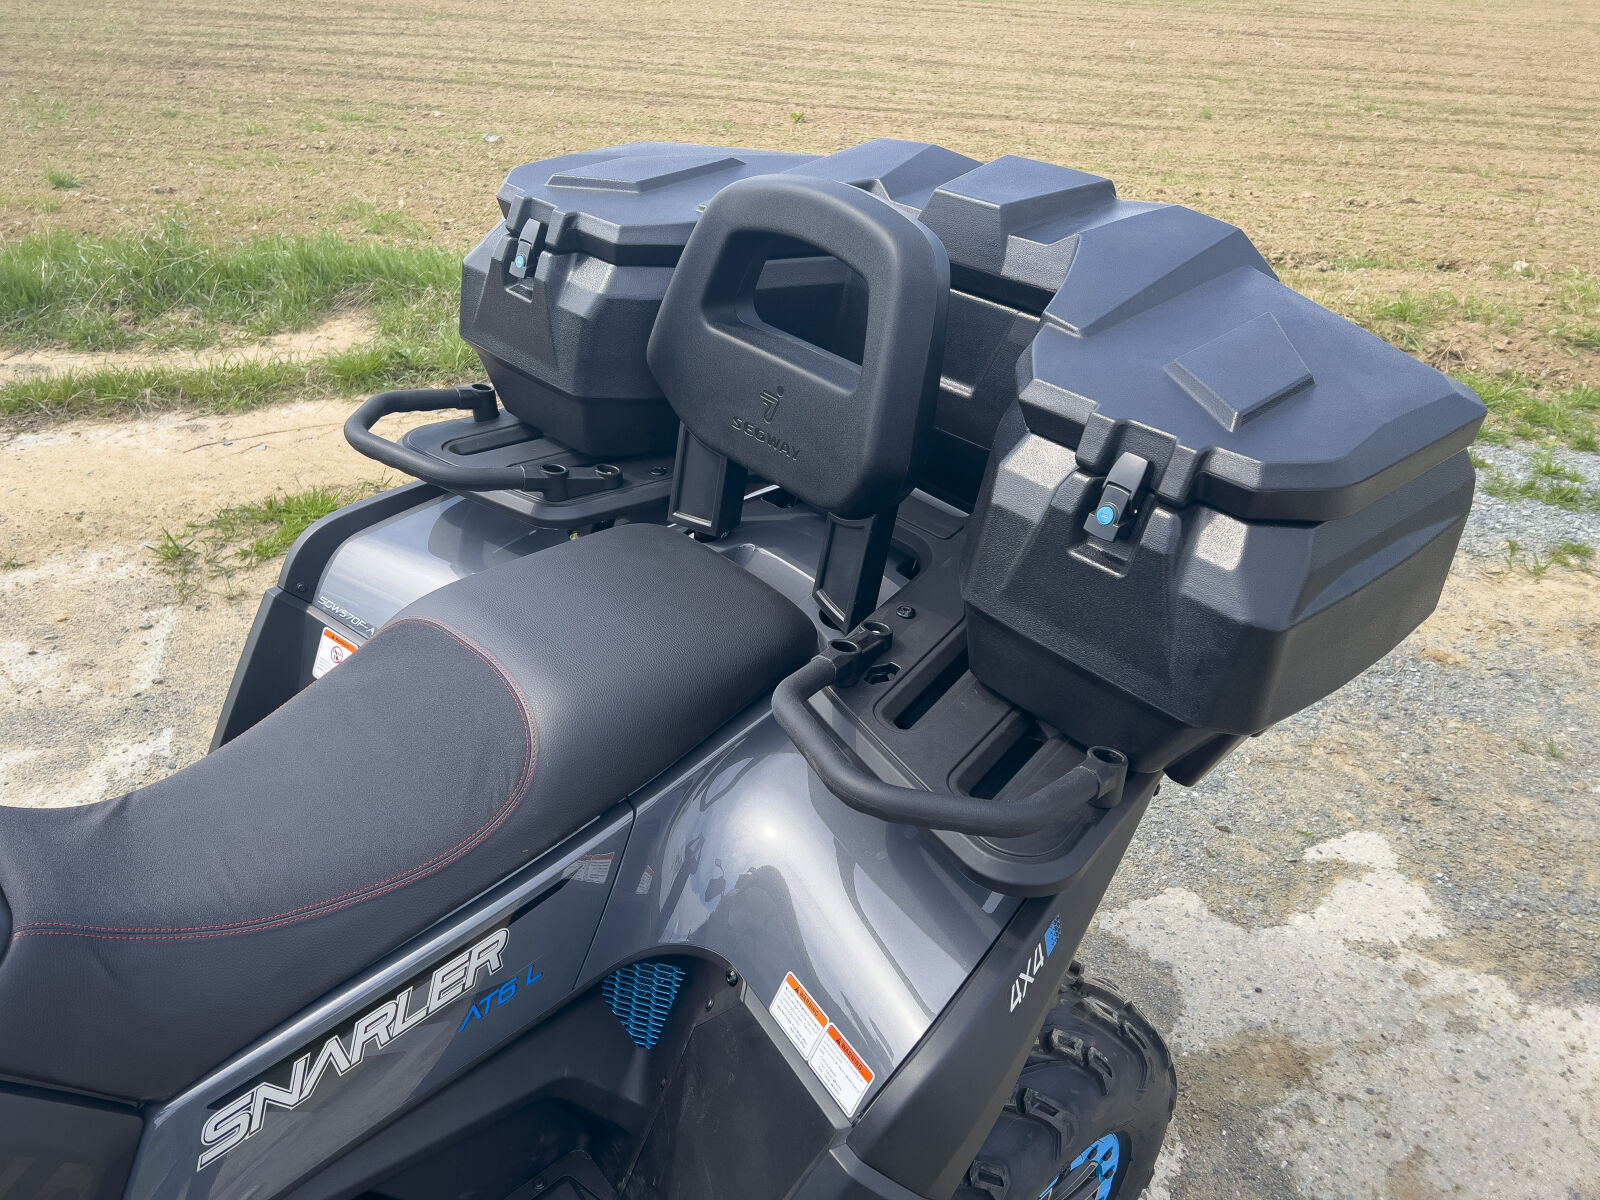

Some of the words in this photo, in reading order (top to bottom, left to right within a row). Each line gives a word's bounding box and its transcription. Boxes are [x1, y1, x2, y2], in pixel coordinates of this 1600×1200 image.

[731, 416, 800, 460] SEGWAY
[458, 976, 519, 1033] AT6
[526, 965, 544, 986] L
[799, 992, 819, 1016] WARNING
[1010, 943, 1044, 1013] 4X4
[197, 927, 510, 1172] SNARLER
[841, 1044, 863, 1071] WARNING
